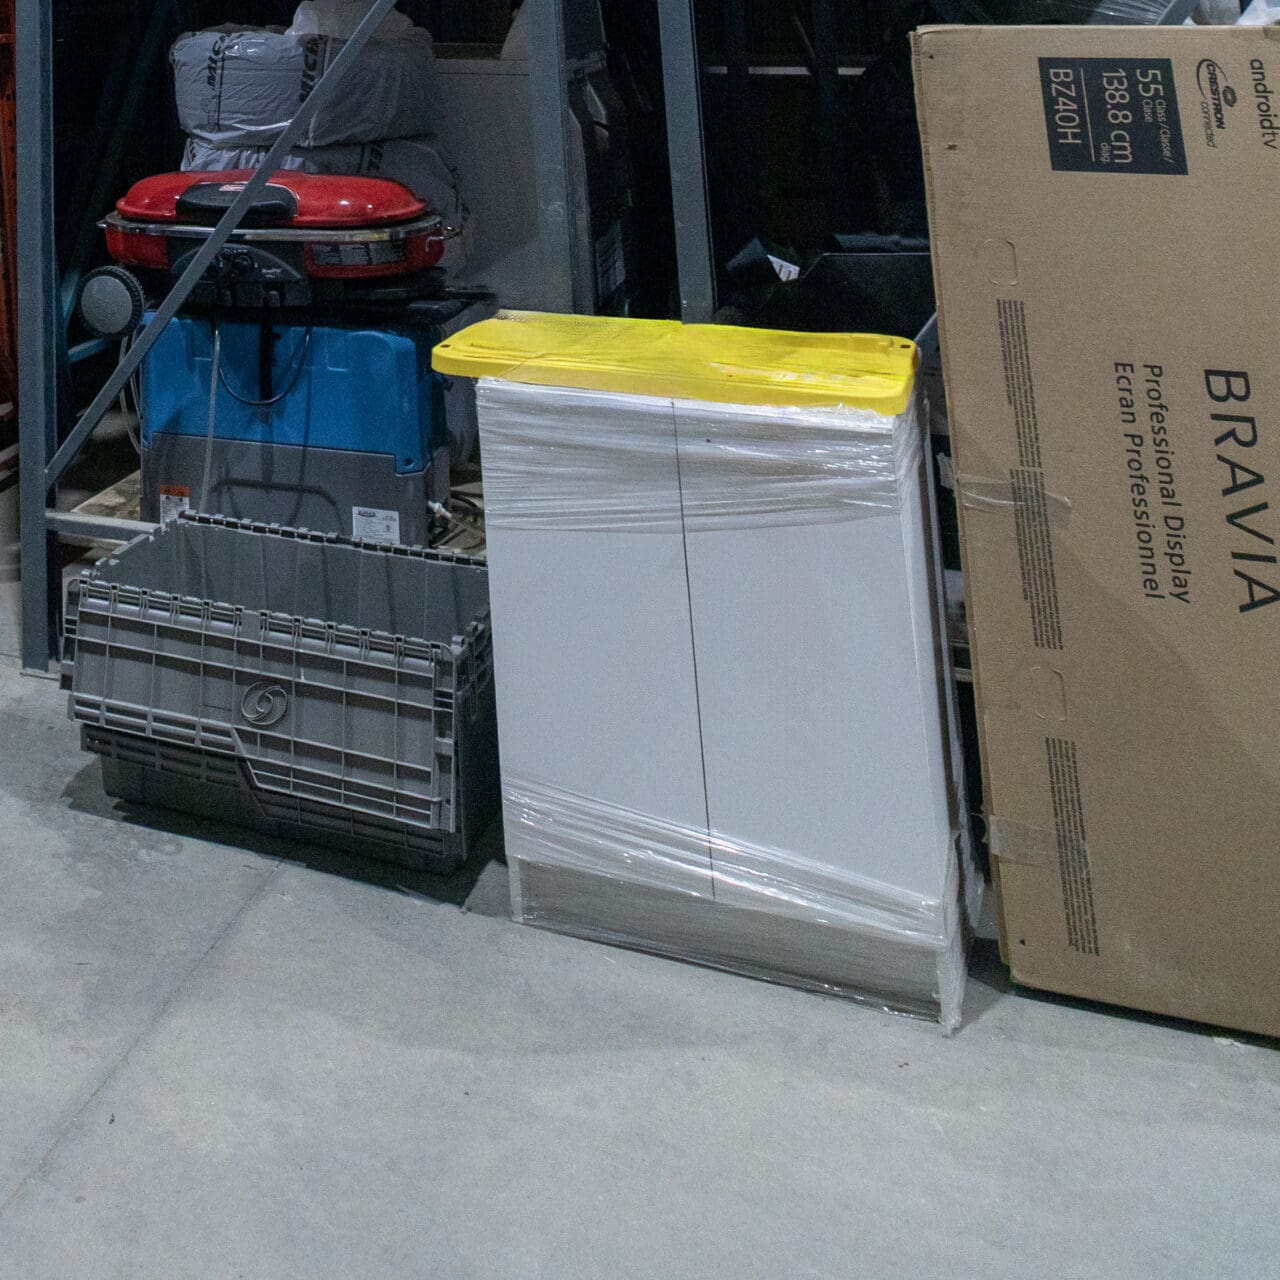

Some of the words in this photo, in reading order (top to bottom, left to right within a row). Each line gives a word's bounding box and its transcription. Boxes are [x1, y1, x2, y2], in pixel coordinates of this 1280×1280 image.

[1048, 68, 1083, 144] BZ40H
[1102, 68, 1134, 124] 138.8
[1136, 69, 1165, 97] 55
[1142, 99, 1154, 123] Clase
[1206, 61, 1226, 130] CRESTRON
[1110, 128, 1134, 164] cm
[1200, 101, 1218, 148] connected
[1114, 361, 1138, 424] Ecran
[1143, 363, 1182, 507] Professional
[1164, 514, 1192, 604] Display
[1204, 368, 1280, 613] BRAVIA
[1124, 433, 1166, 599] Professionnel
